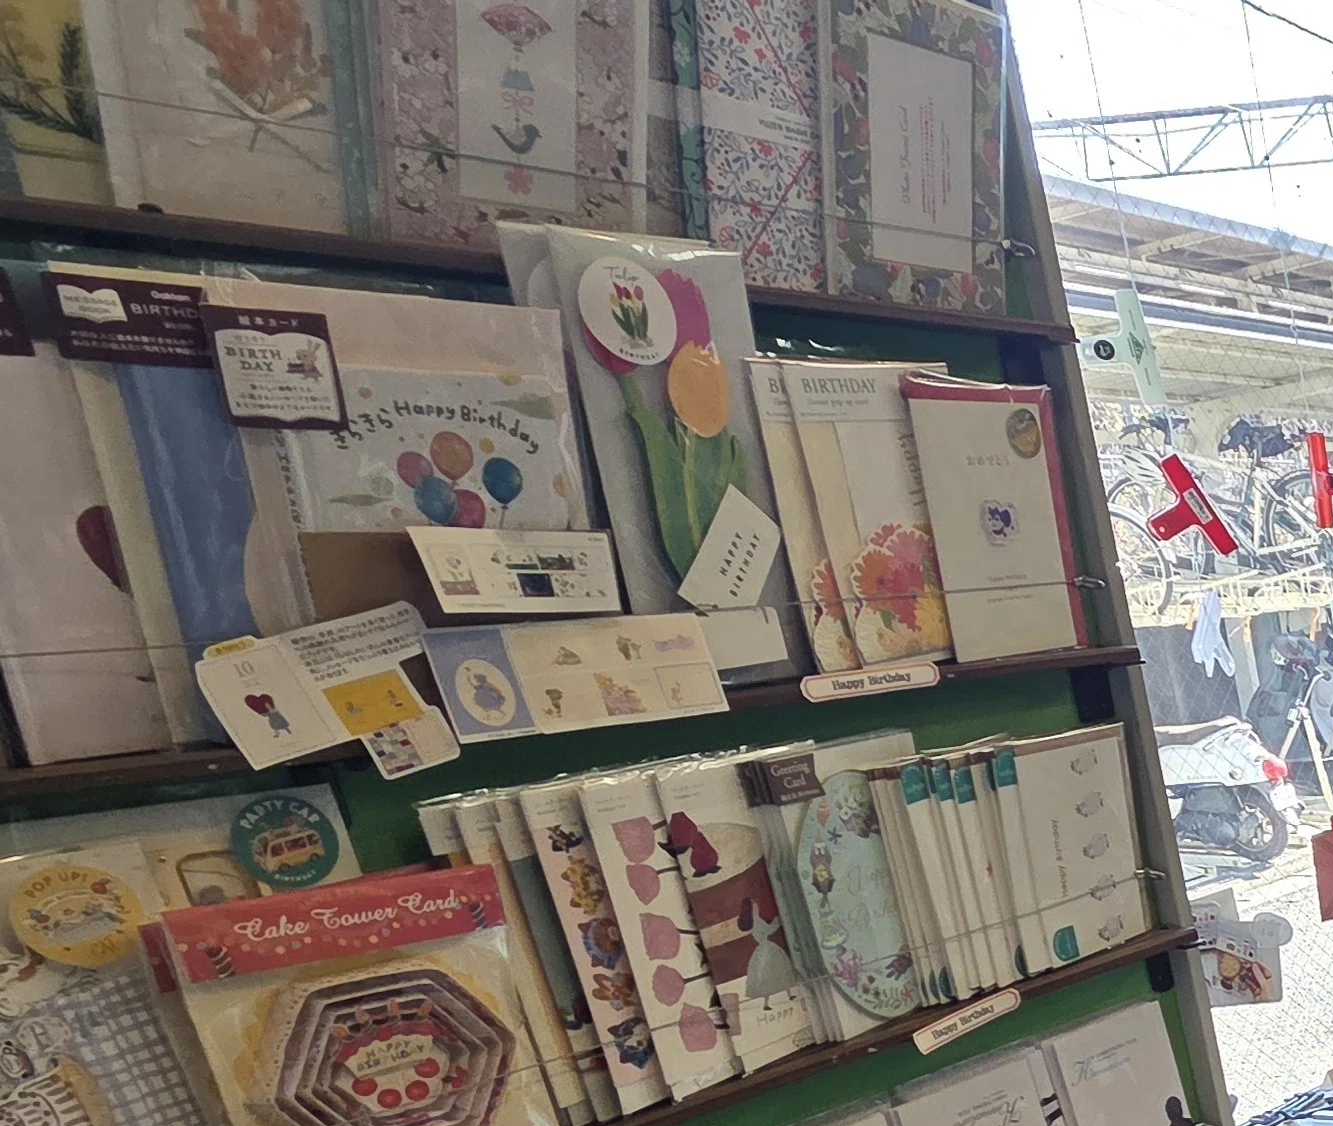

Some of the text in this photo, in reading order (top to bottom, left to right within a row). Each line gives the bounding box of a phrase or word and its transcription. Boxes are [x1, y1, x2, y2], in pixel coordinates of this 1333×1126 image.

[131, 303, 200, 319] BIRTHD
[224, 344, 283, 361] BIRTH
[240, 359, 275, 373] DAY
[802, 377, 877, 394] BIRTHDAY
[393, 400, 540, 455] Happy Birthday
[719, 531, 745, 577] HAPPY
[729, 532, 761, 598] BIRTHDAY
[233, 660, 256, 678] 10
[831, 671, 912, 692] Happy Birthday
[770, 761, 810, 780] Greeting
[783, 776, 808, 791] Card
[240, 799, 322, 830] PARTY CAR
[24, 875, 53, 899] POP
[233, 889, 461, 942] Cake Tower Card
[757, 1006, 794, 1026] Happy
[930, 1004, 996, 1040] Happy Birthday
[356, 1044, 425, 1070] BIRHDAY
